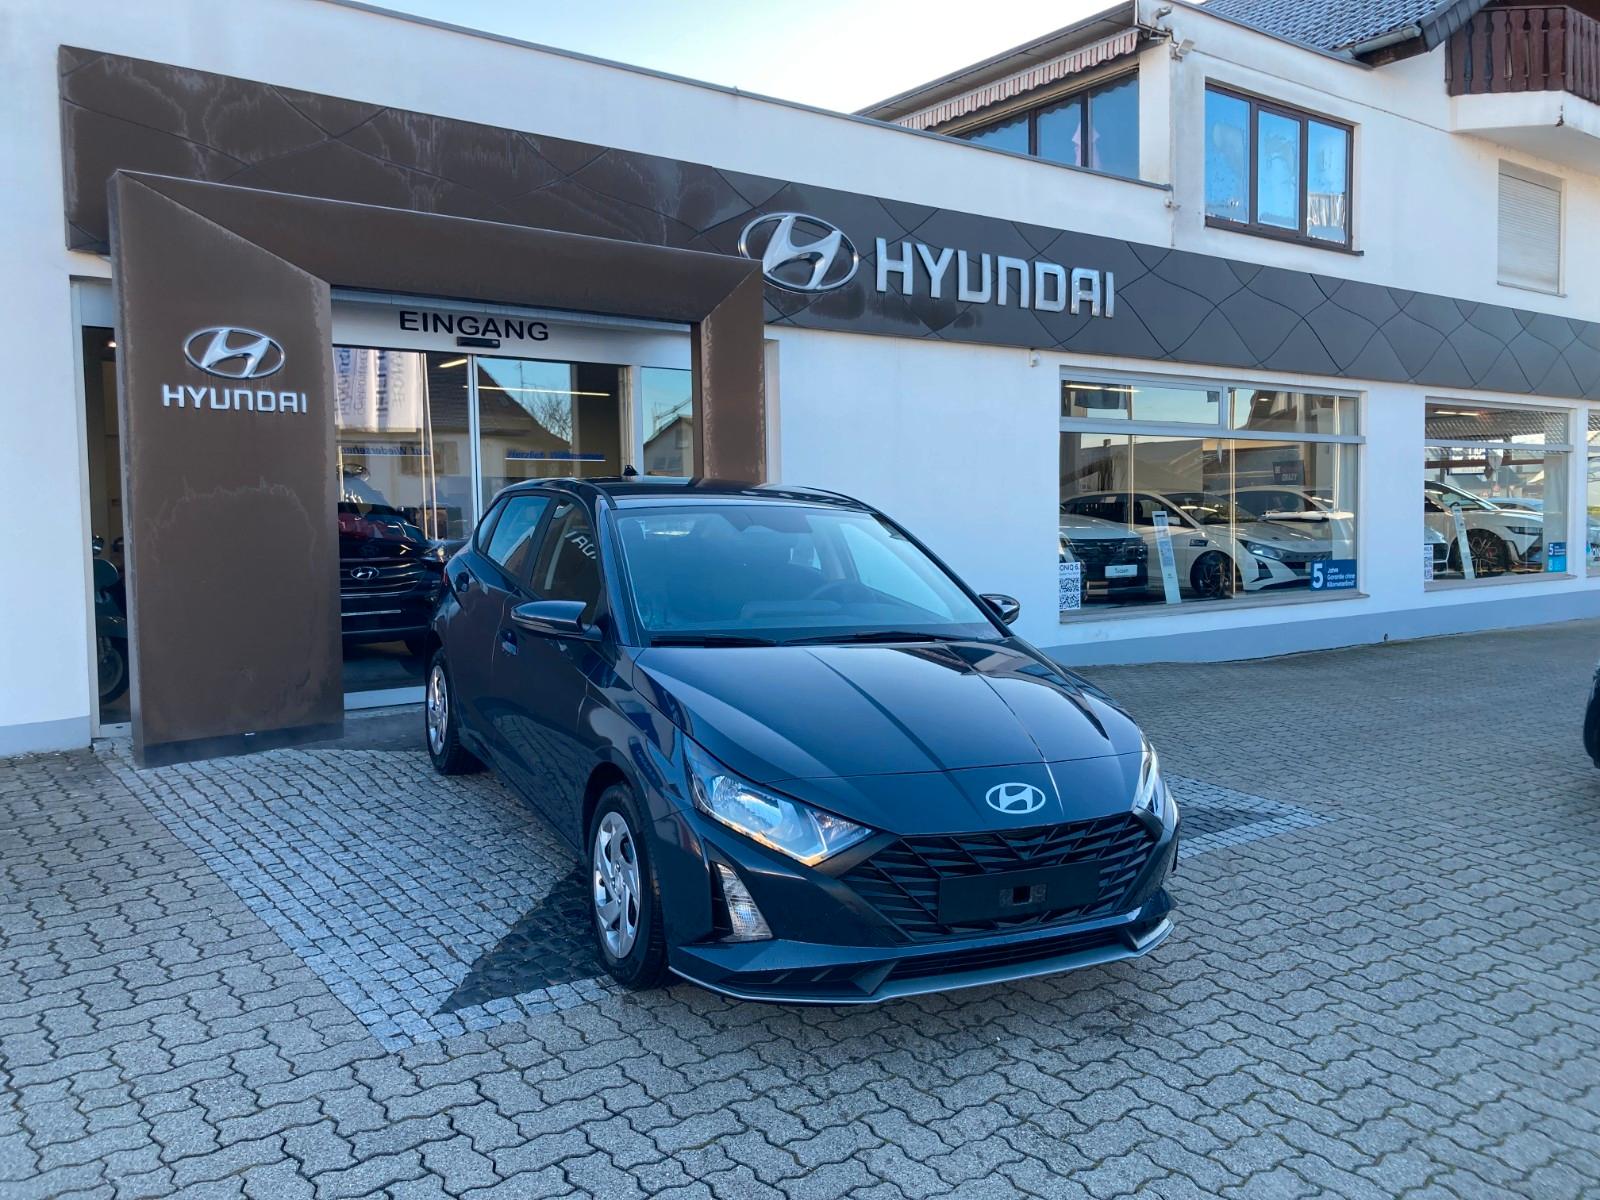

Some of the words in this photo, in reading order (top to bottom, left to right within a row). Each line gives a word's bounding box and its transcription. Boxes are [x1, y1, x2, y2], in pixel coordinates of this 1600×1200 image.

[875, 237, 1115, 318] HYUNDAI
[399, 310, 549, 341] EINGANG
[162, 384, 307, 413] HYUNDAI
[1312, 562, 1324, 588] 5
